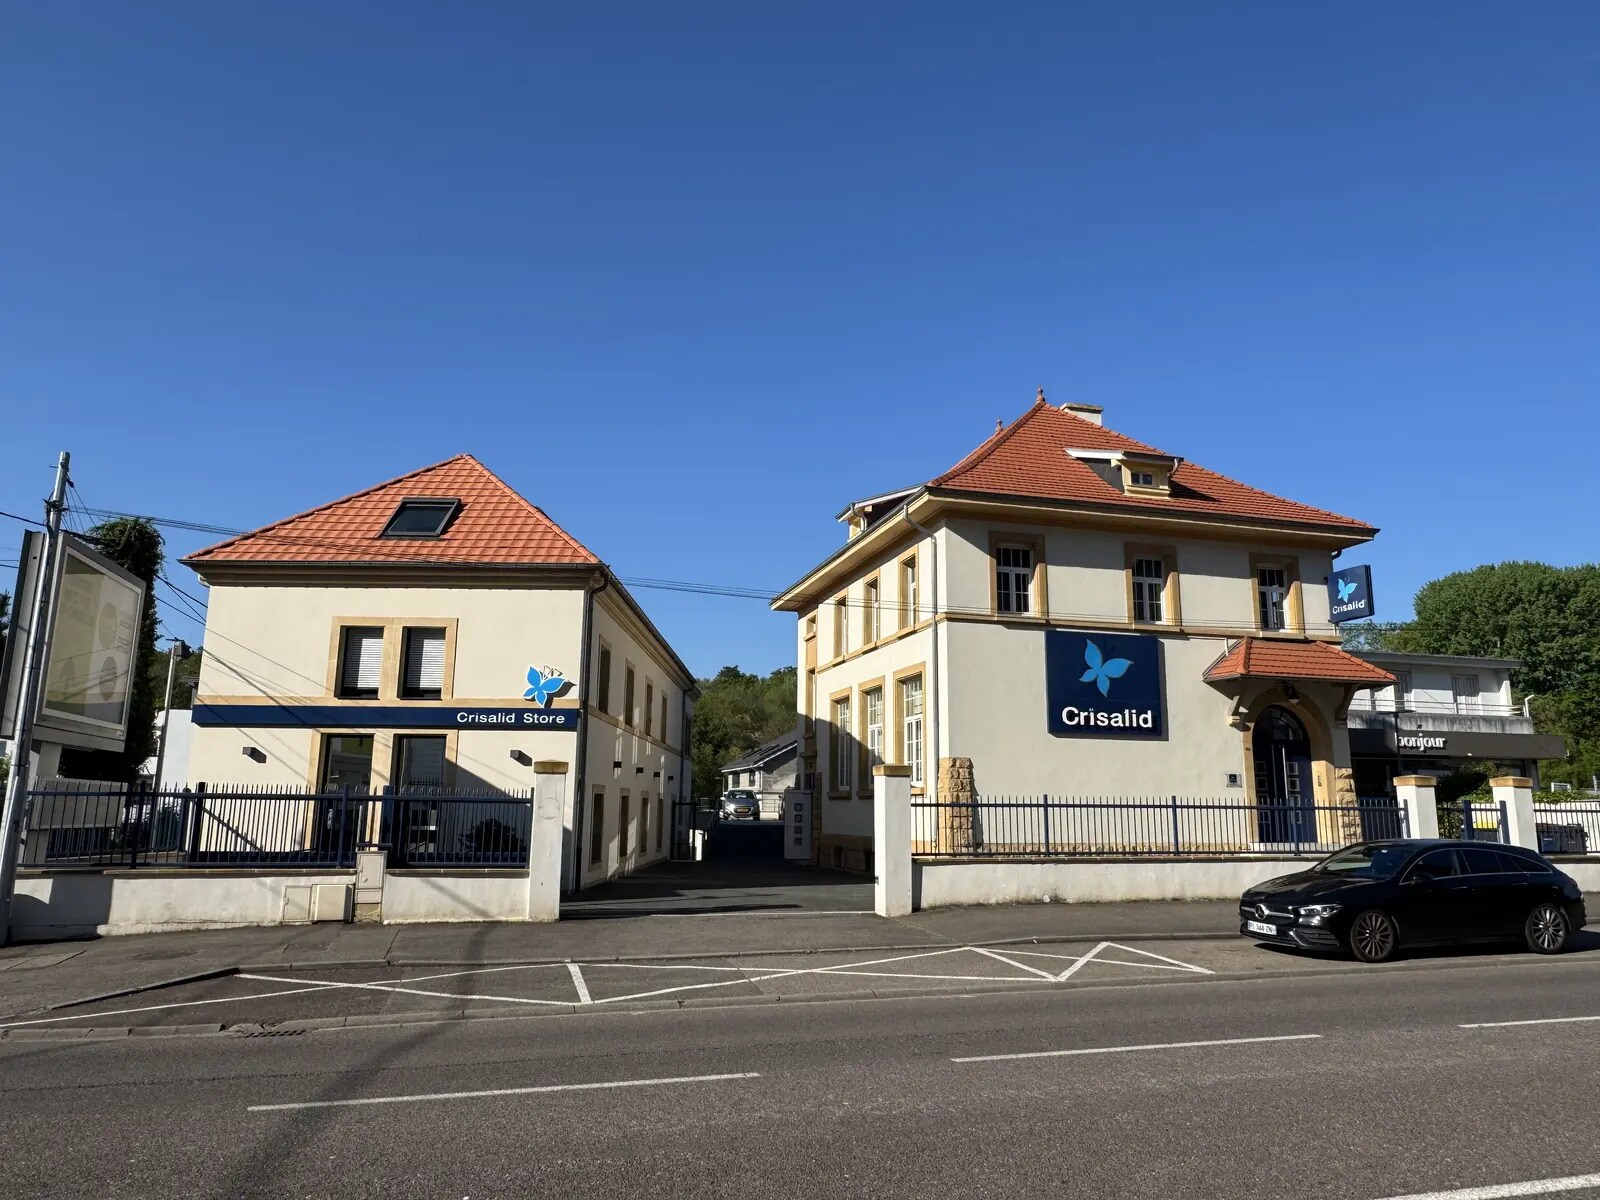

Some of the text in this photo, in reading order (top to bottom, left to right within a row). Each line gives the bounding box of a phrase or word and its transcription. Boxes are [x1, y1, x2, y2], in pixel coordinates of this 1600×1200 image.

[1332, 599, 1365, 614] Crisalid
[456, 711, 566, 725] Crisalid Store
[1061, 706, 1153, 728] Crisalid
